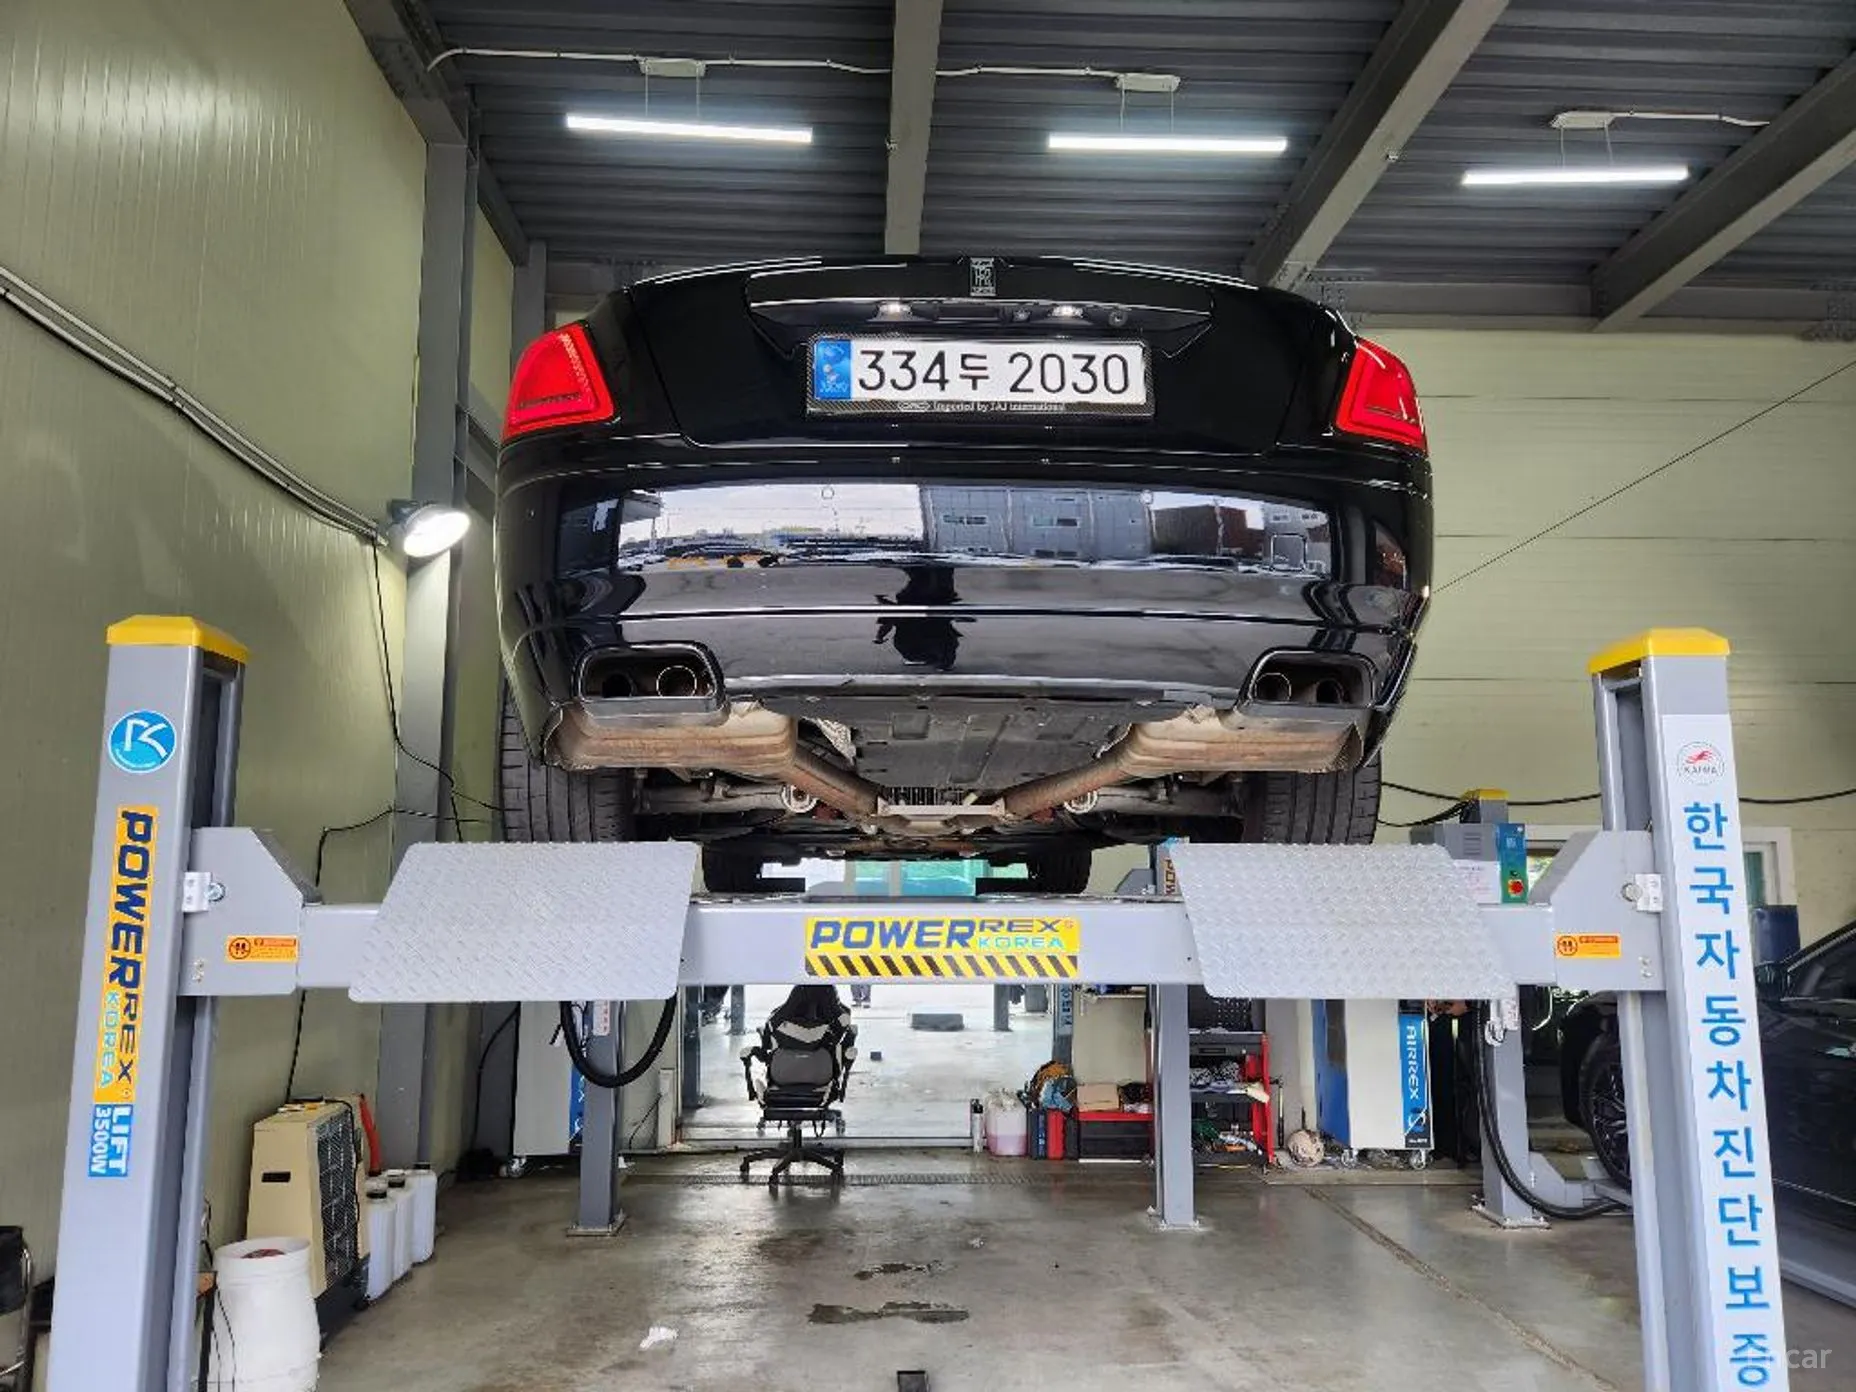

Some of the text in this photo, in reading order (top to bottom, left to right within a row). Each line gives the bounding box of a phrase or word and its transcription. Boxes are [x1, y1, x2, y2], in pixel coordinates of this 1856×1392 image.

[858, 350, 1129, 394] 334두 2030
[977, 936, 1064, 948] KOREA
[101, 990, 119, 1088] KOREA
[91, 1107, 111, 1175] 3500W
[109, 1106, 131, 1175] LIFT
